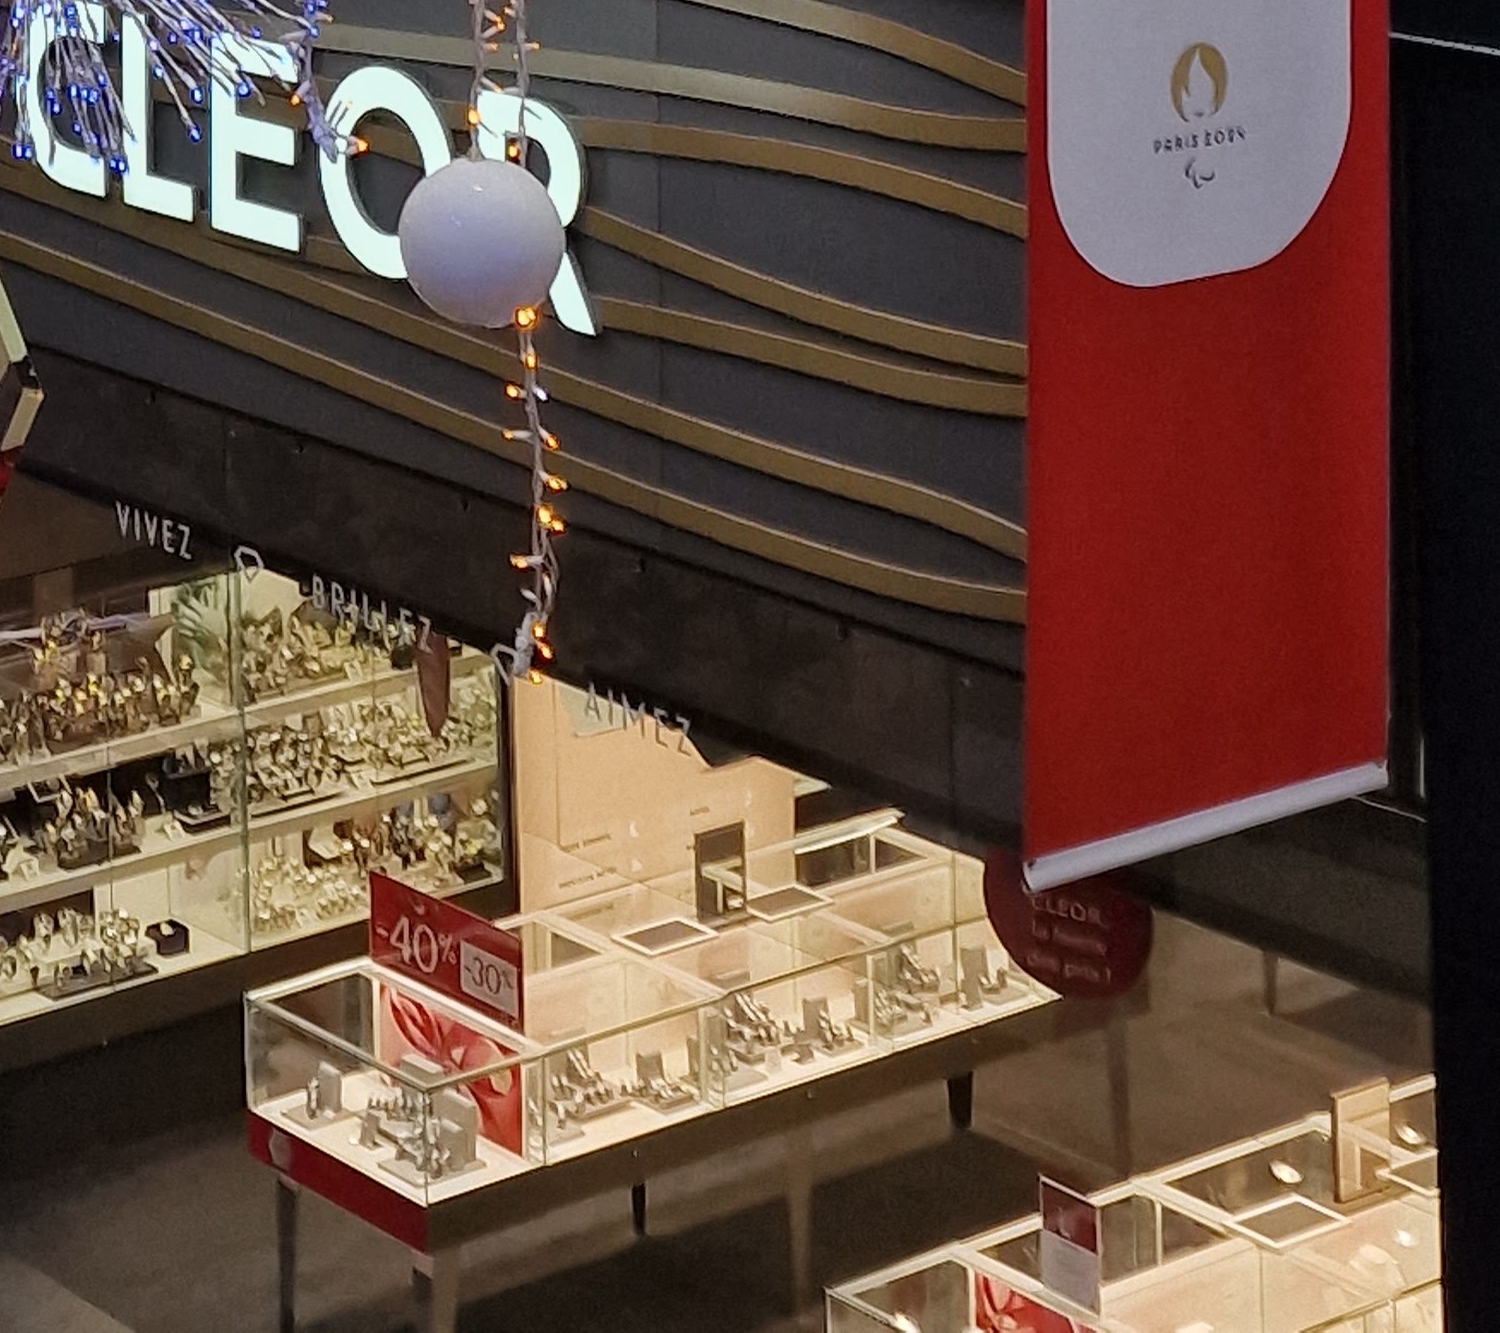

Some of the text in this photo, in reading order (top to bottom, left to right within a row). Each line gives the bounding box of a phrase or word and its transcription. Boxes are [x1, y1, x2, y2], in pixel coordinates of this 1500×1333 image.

[114, 499, 693, 757] VIVEZ BRILLEZ AIMEZ
[375, 914, 457, 974] -40%
